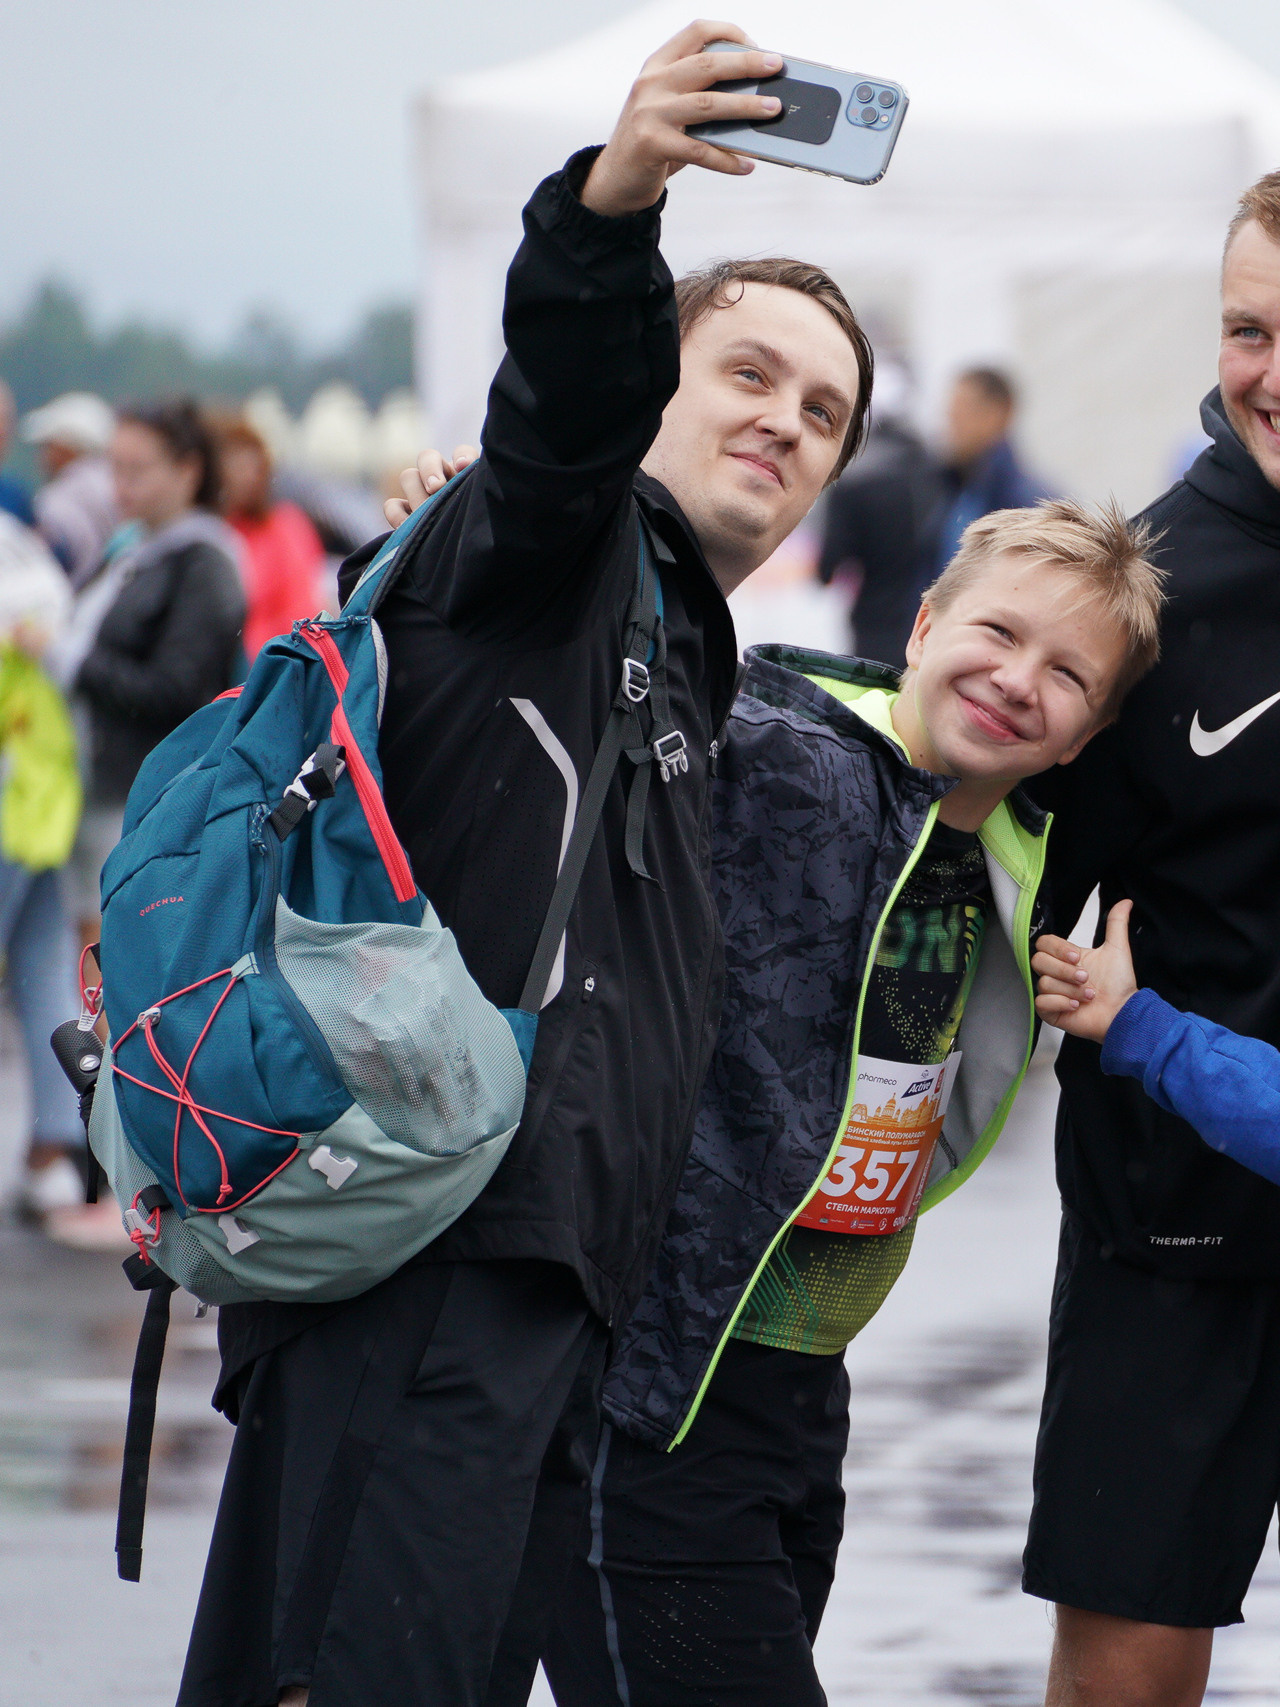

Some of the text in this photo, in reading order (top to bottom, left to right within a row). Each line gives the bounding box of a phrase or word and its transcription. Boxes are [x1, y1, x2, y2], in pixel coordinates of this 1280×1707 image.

[139, 896, 184, 917] QUECHUA
[857, 1072, 898, 1087] pharmeco
[908, 1081, 931, 1094] Active
[819, 1145, 920, 1202] 357
[825, 1201, 897, 1215] СТЕПАН МАРКОТИН
[1149, 1235, 1223, 1246] THERMA-FIT
